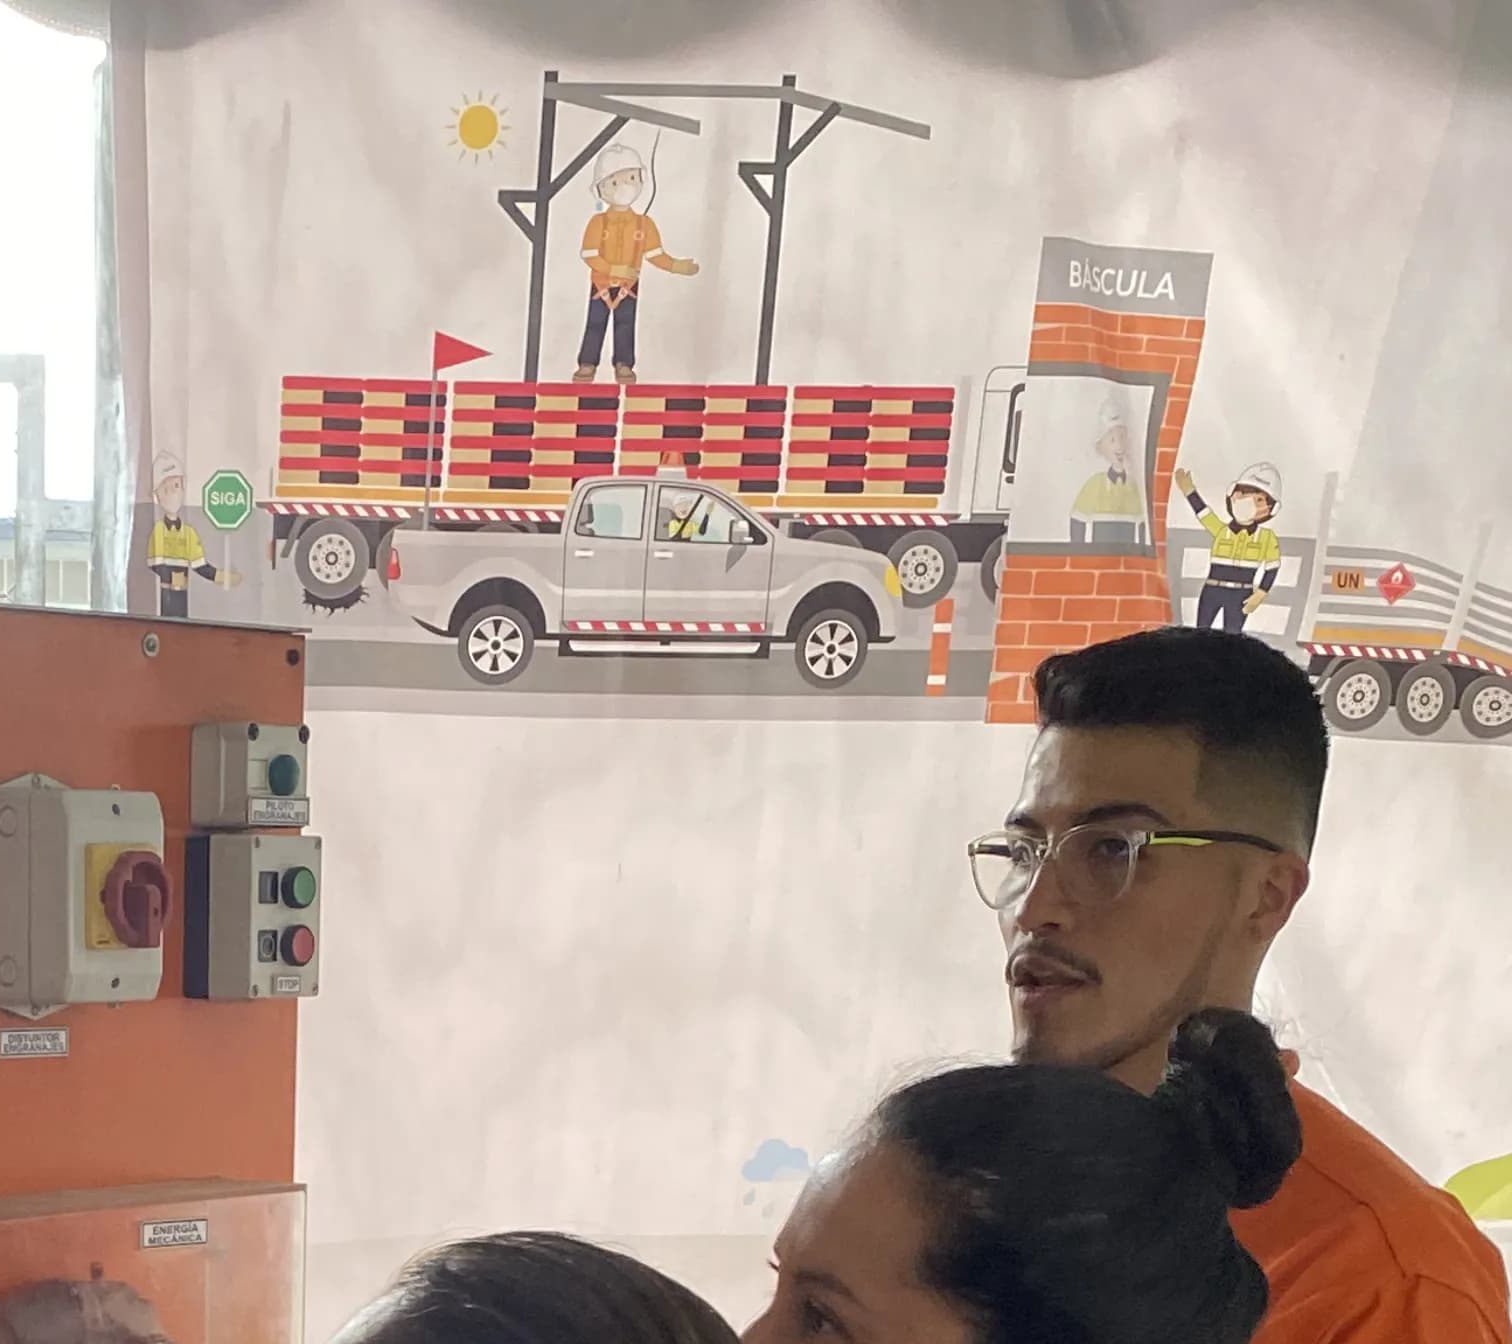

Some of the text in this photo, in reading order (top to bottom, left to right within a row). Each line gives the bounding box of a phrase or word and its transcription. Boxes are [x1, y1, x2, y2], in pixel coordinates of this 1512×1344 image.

[1069, 258, 1176, 300] BÁSCULA
[210, 491, 245, 506] SIGA
[1337, 572, 1360, 589] UN
